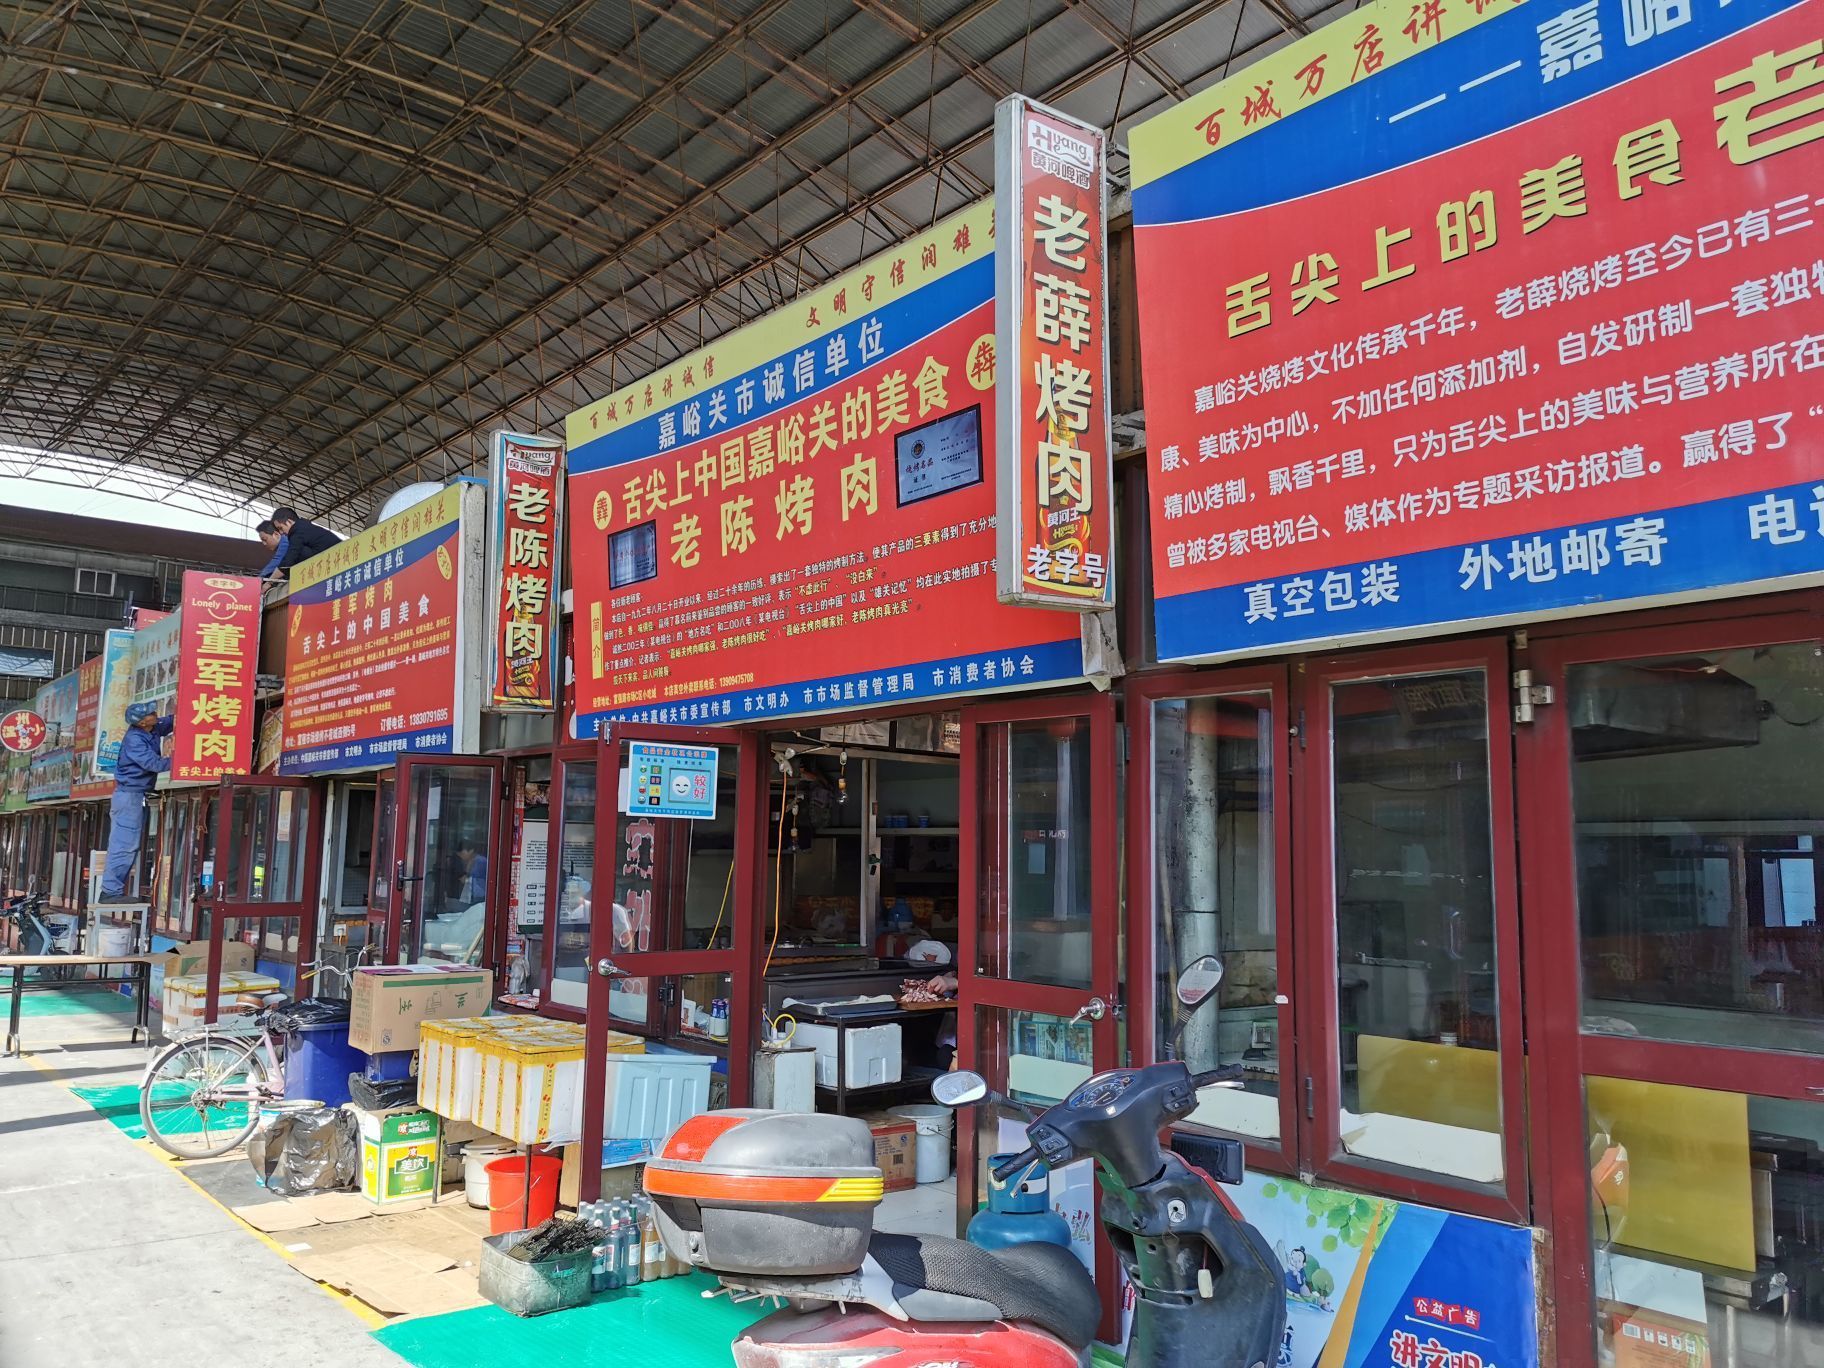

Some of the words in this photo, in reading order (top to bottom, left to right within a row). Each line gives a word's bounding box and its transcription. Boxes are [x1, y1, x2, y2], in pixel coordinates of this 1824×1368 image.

[1195, 0, 1521, 147] 百城万店讲
[1032, 151, 1090, 188] 黄河啤酒
[1225, 119, 1686, 337] 舌尖上的美食
[657, 316, 886, 451] 嘉峪关市诚信单位
[1033, 194, 1091, 513] 老薛烤肉
[622, 354, 951, 524] 舌尖上中国嘉峪关的美食
[670, 452, 878, 570] 老陈烤肉
[1027, 543, 1106, 588] 老字号
[192, 597, 221, 610] Lonely
[226, 600, 253, 612] planet
[302, 593, 430, 656] 舌尖上的中国美食
[325, 547, 405, 598] 嘉峪关市诚信单位
[505, 482, 550, 659] 老陈烤肉
[1242, 561, 1402, 625] 真空包装
[1458, 516, 1669, 592] 外地邮寄
[190, 622, 246, 764] 董军烤肉
[743, 690, 790, 713] 市文明办
[803, 672, 915, 705] 市市场监督管理局
[932, 654, 1035, 688] 市消费者协会
[1416, 1298, 1478, 1326] 公益广告
